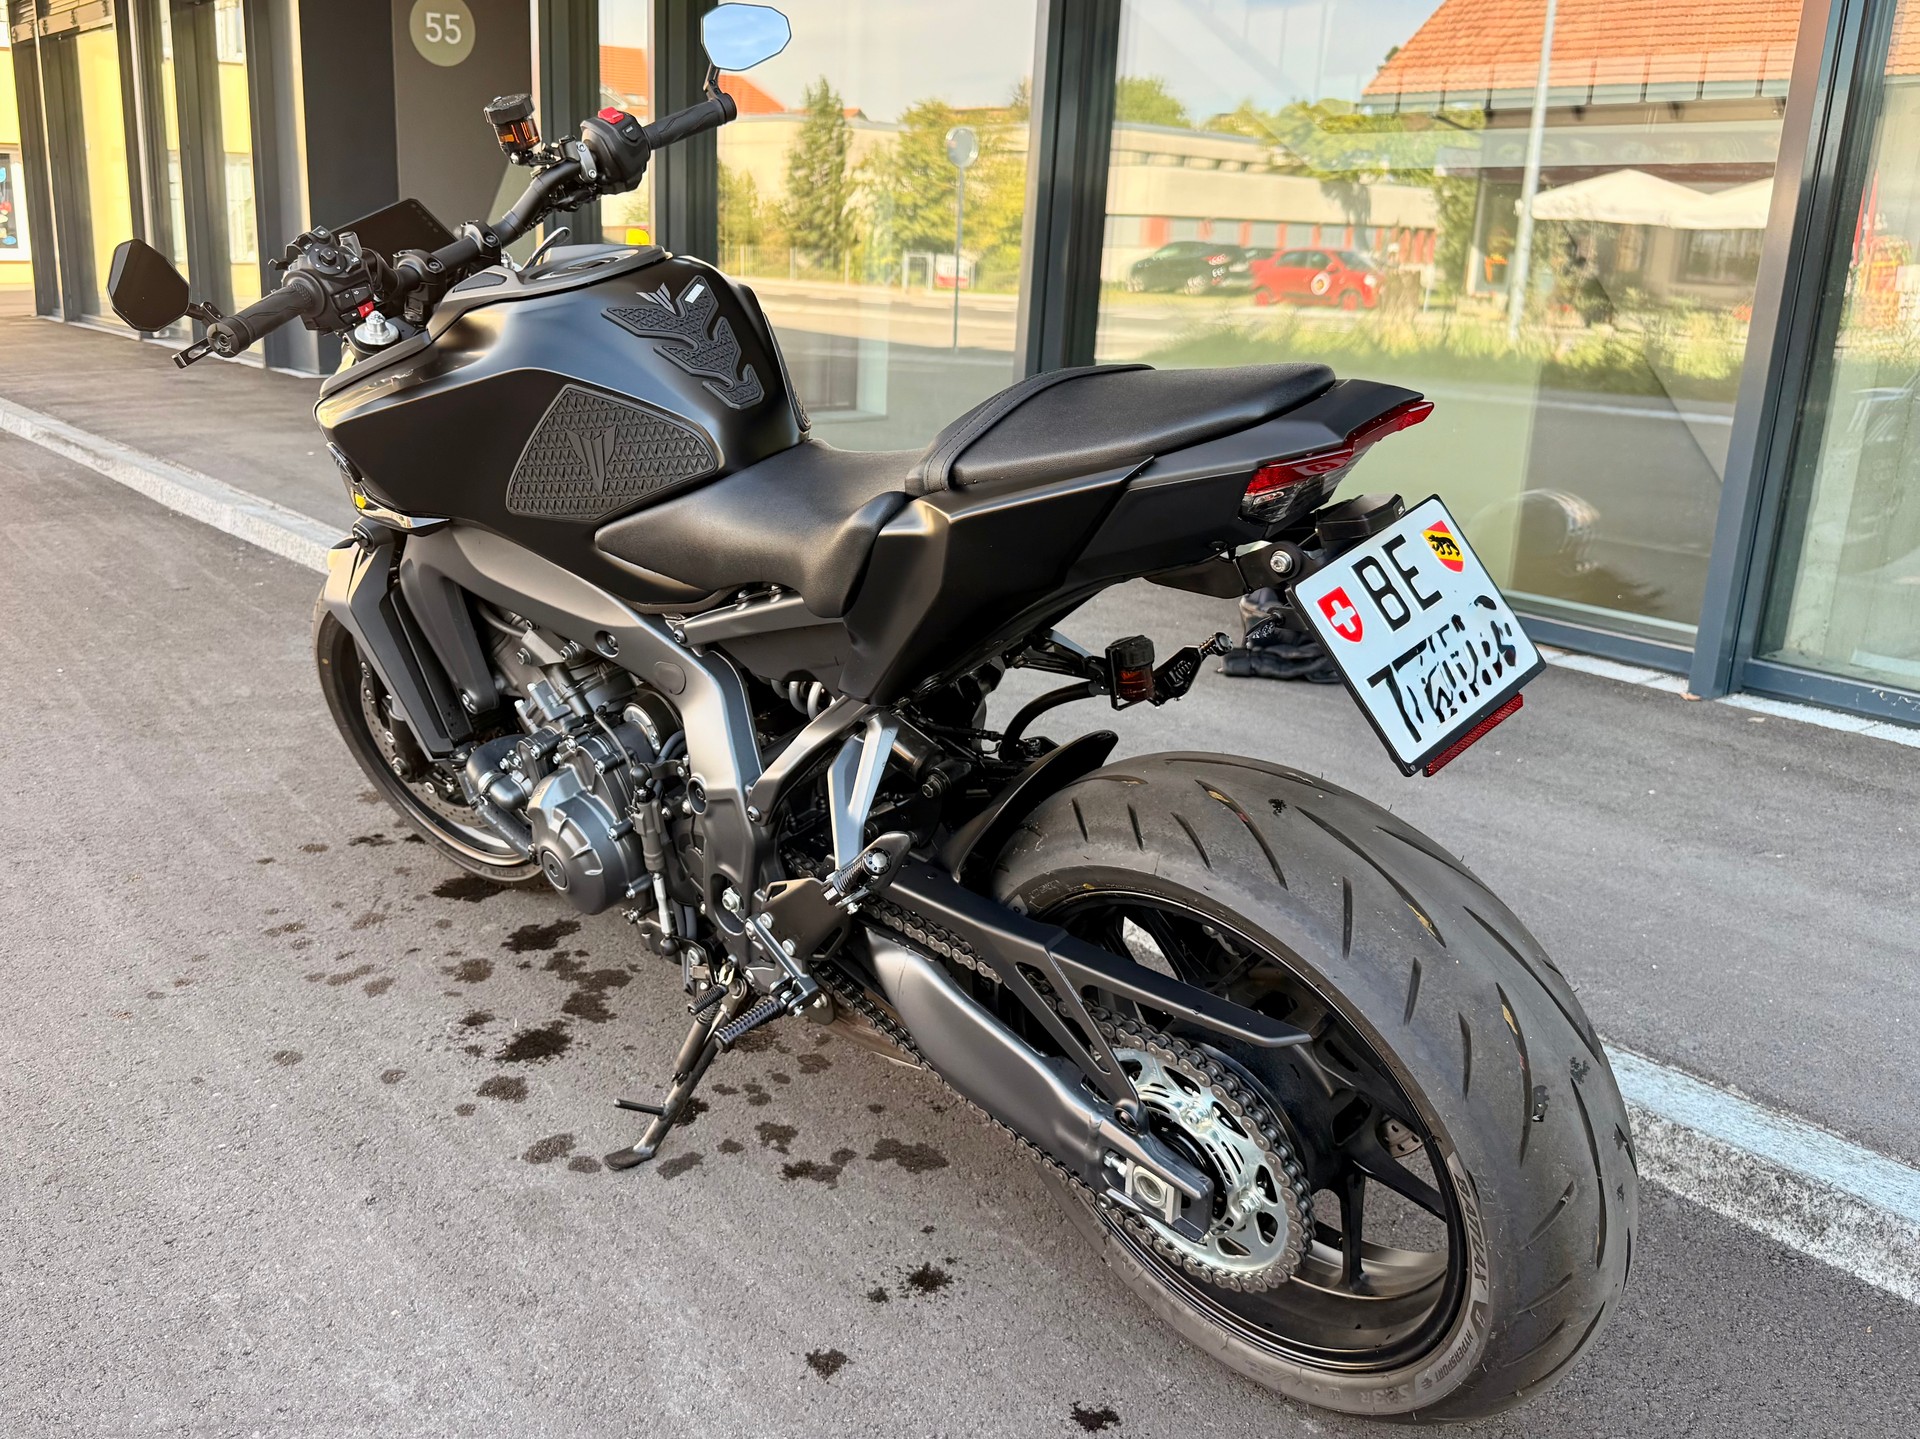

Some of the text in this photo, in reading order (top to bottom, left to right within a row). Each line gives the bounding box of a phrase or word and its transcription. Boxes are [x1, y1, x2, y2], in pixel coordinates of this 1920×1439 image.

[425, 12, 461, 44] 55
[1350, 533, 1443, 632] BE
[1454, 1172, 1487, 1291] BATTLAX
[1434, 1328, 1474, 1383] HYPERSPORT
